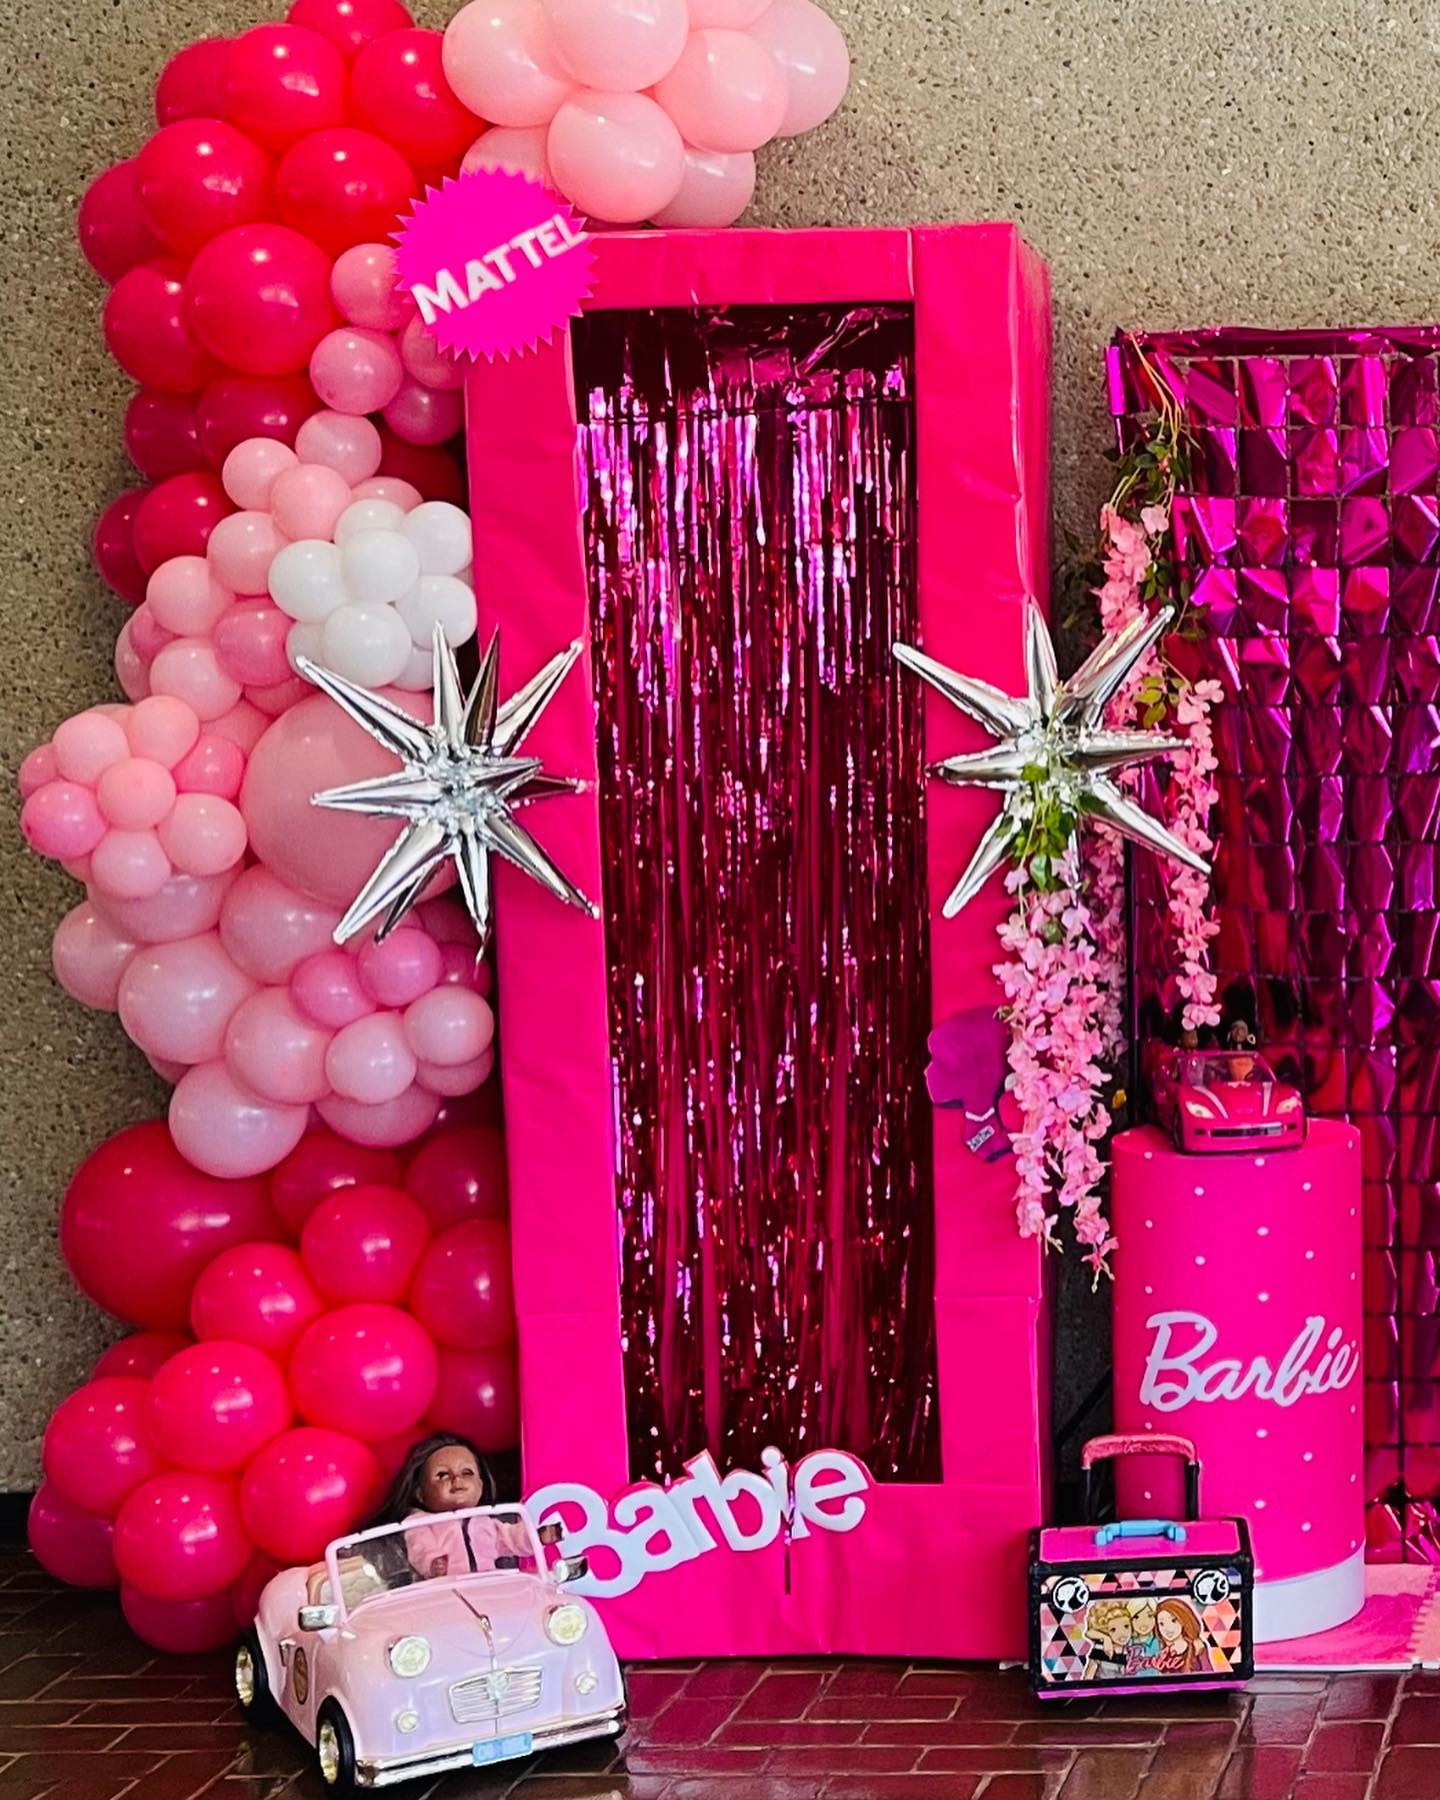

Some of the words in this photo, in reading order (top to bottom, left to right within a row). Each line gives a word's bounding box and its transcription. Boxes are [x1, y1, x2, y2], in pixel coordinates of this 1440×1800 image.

[410, 213, 588, 325] MATTEL
[1139, 1311, 1359, 1412] Barbie
[523, 1446, 869, 1598] Barbie
[1126, 1645, 1185, 1674] Barbie
